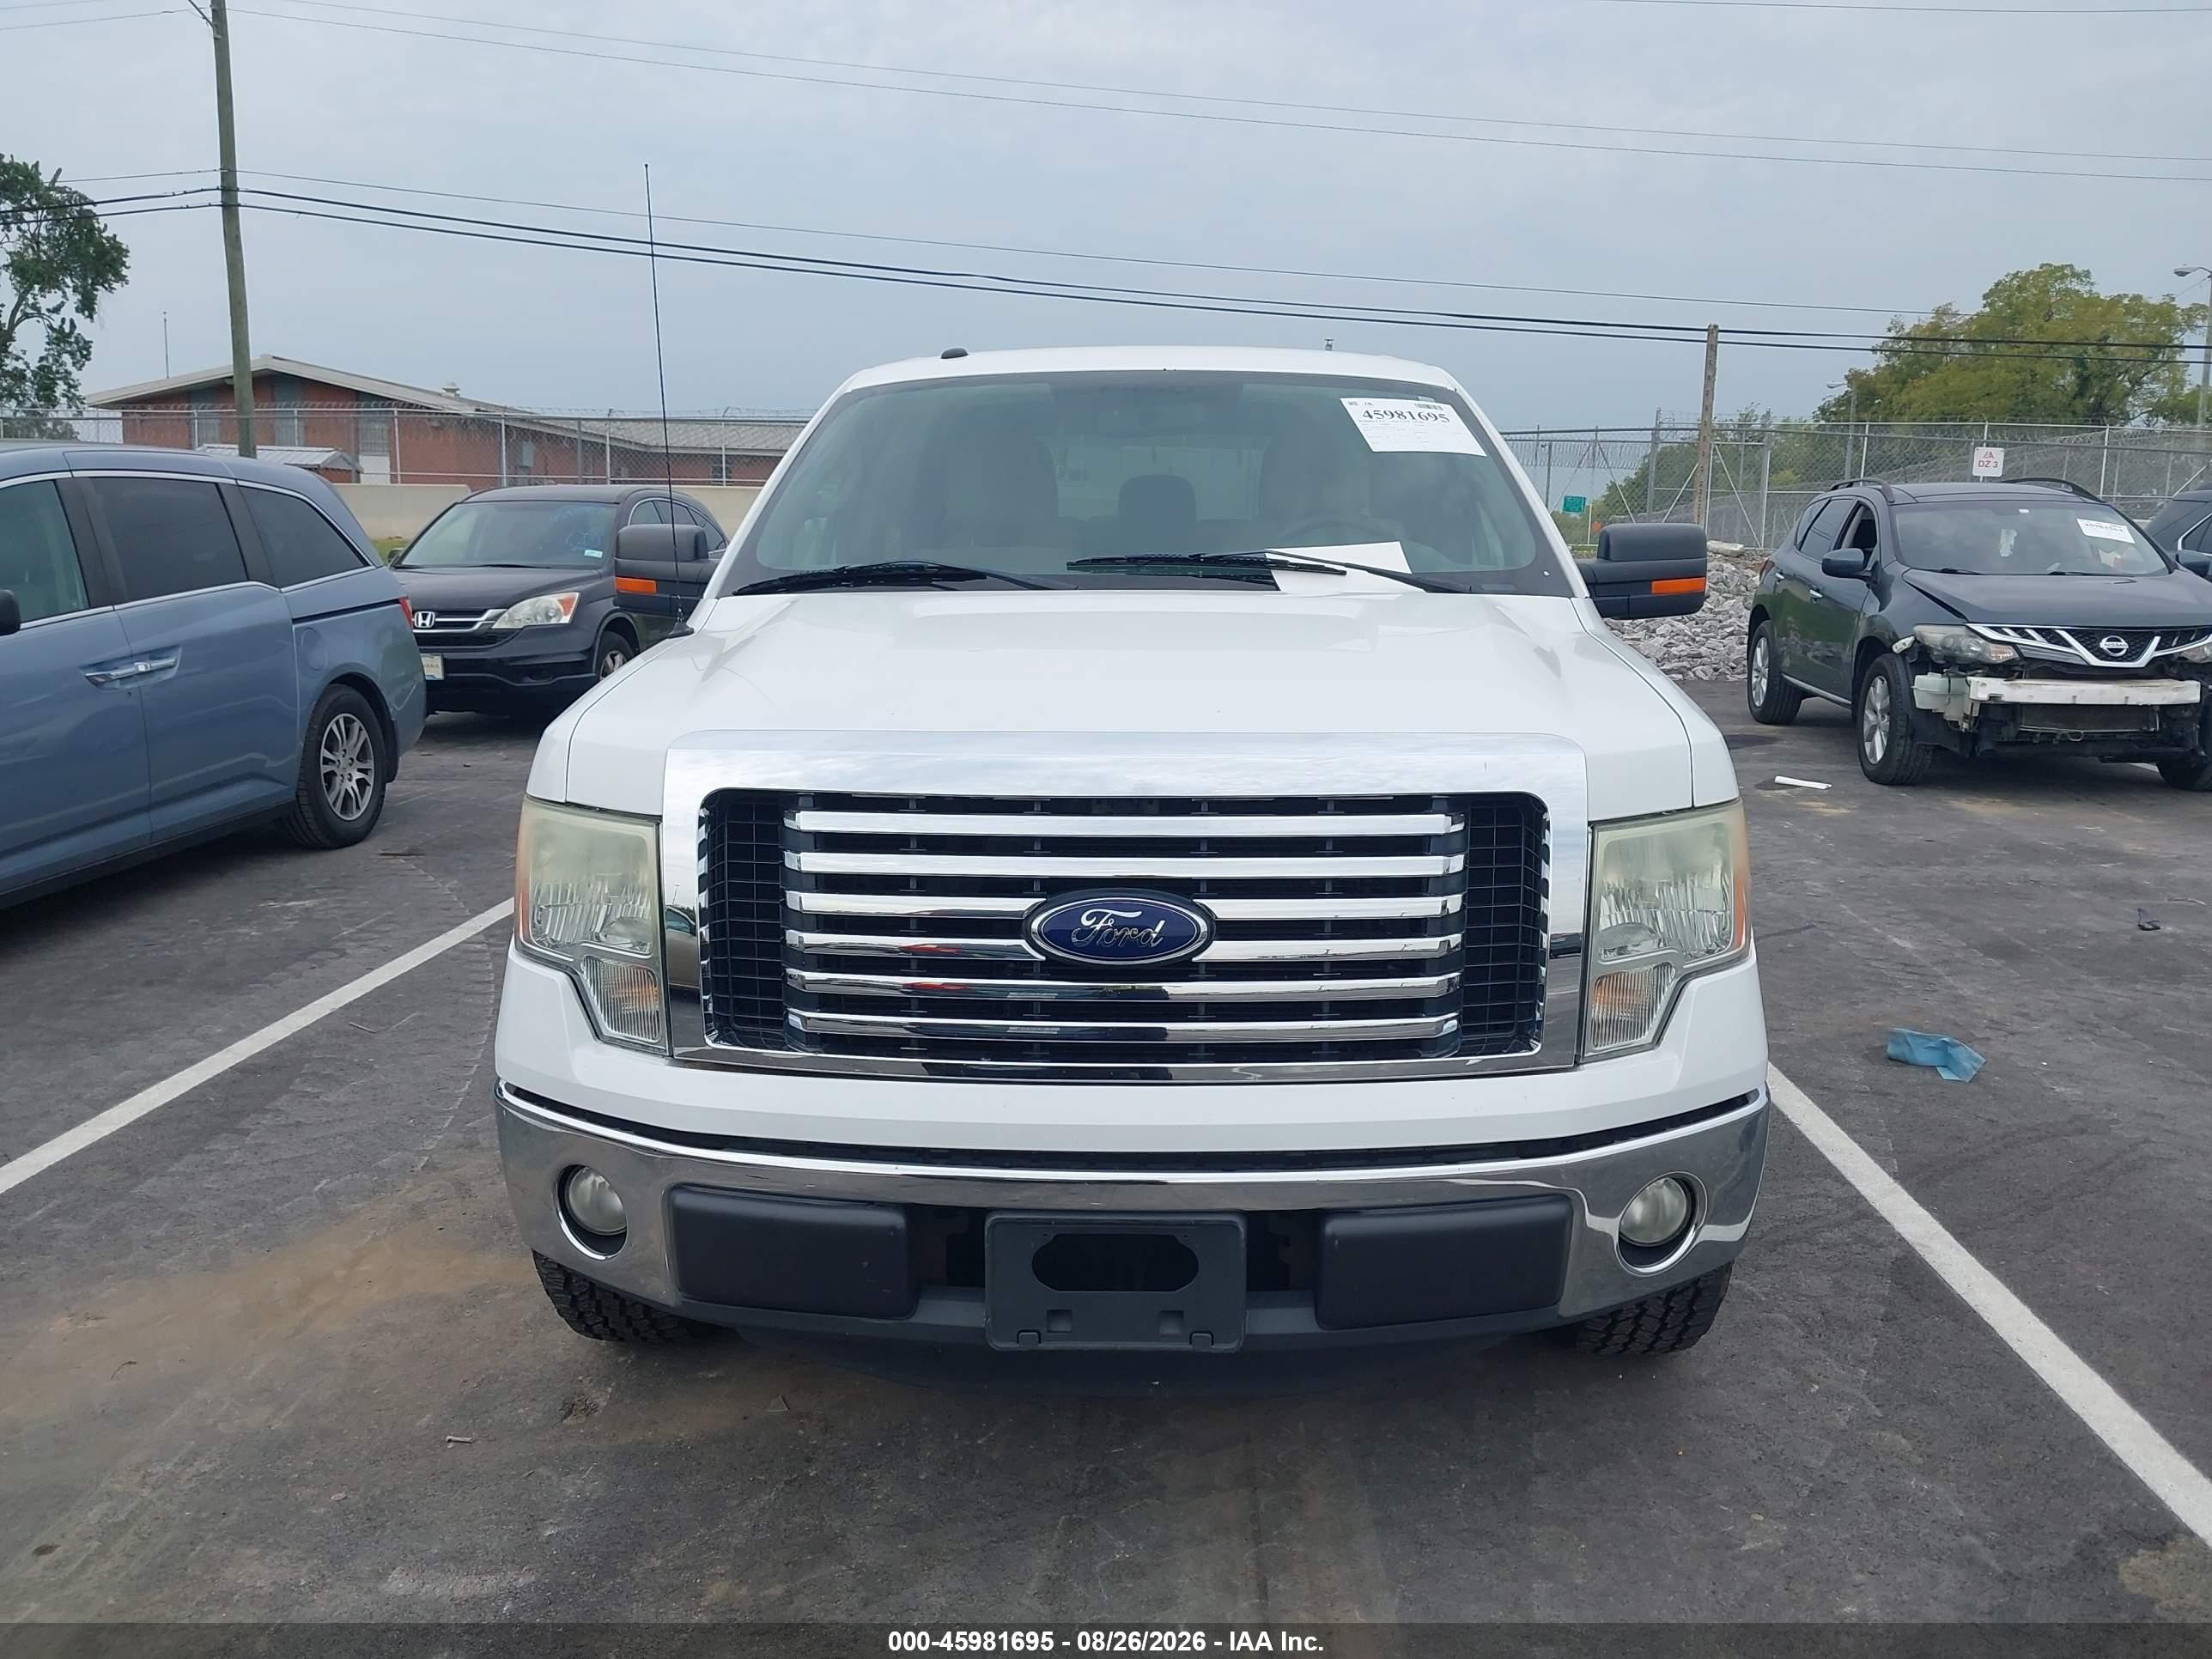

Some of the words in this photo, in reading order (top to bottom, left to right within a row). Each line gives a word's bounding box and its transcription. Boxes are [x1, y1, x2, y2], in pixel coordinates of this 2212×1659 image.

[1362, 409, 1450, 423] 45981695
[1978, 459, 1991, 468] DZ
[1071, 908, 1165, 948] Ford
